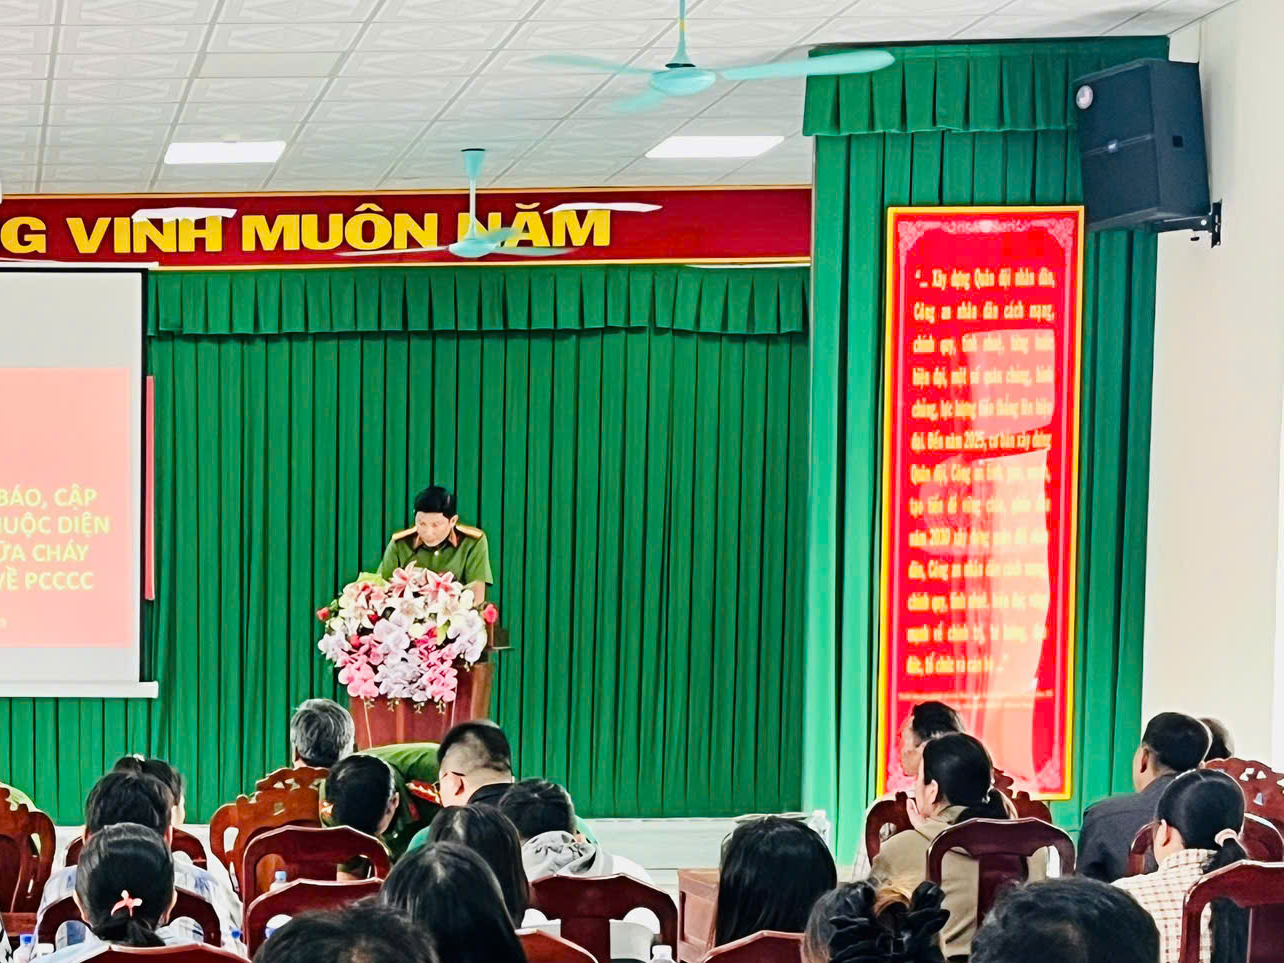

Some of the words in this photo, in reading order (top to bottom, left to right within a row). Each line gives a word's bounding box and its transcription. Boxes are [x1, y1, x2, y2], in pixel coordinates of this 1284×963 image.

[66, 214, 220, 253] VINH
[242, 203, 435, 253] MUÔN
[458, 202, 611, 247] NĂM
[54, 483, 97, 510] CẬP
[57, 511, 110, 538] DIỆN
[32, 539, 90, 562] CHÁY
[25, 571, 94, 590] PCCCC
